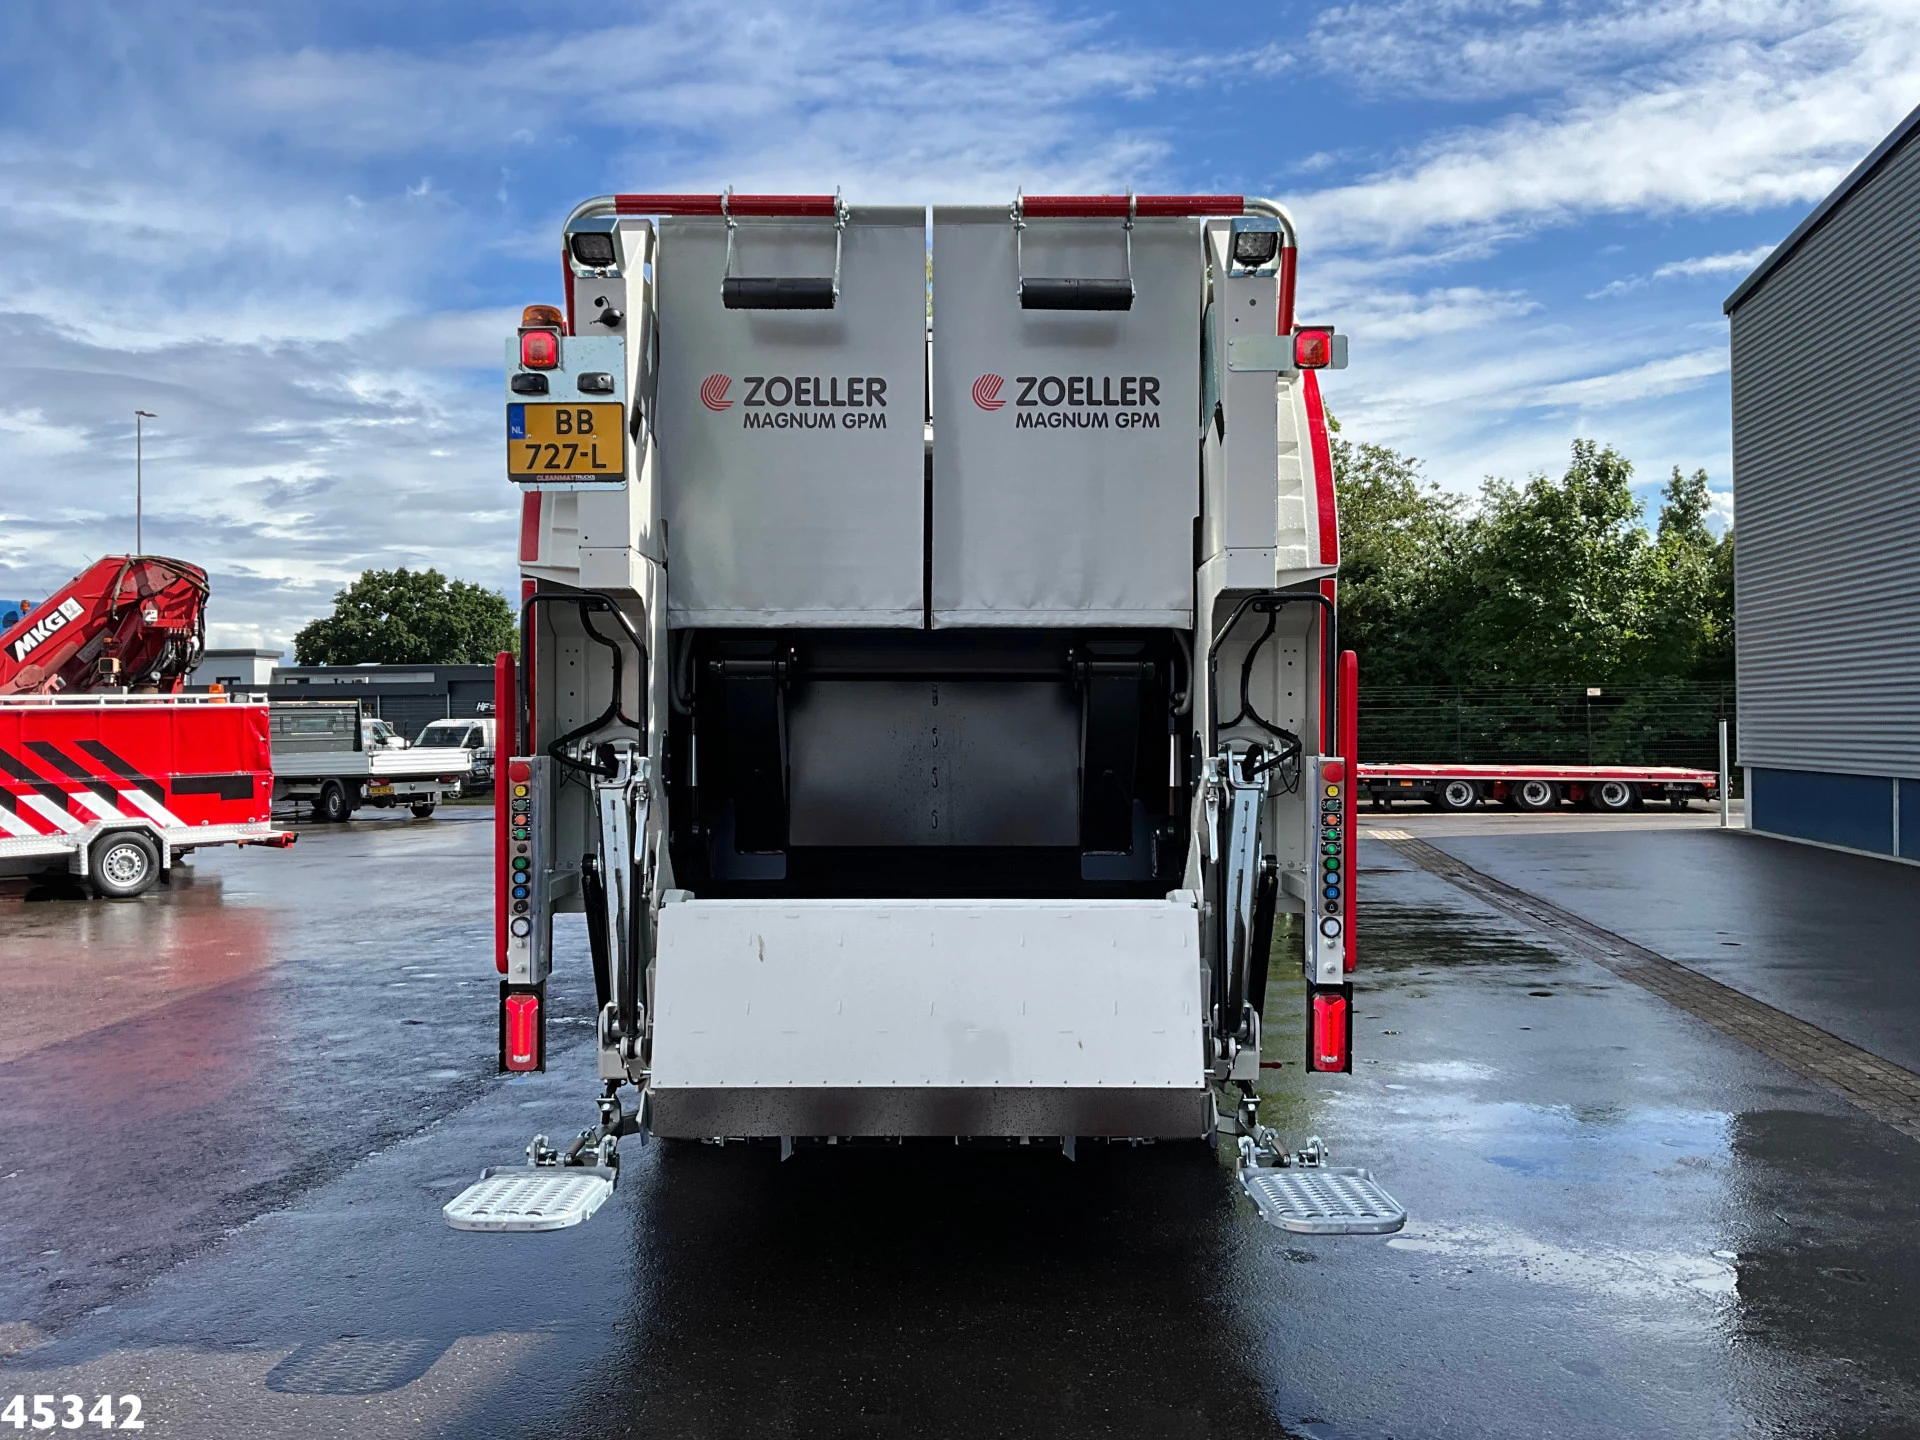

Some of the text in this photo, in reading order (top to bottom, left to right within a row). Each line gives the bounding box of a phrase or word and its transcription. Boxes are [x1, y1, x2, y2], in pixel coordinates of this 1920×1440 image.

[743, 376, 887, 407] ZOELLER
[1016, 376, 1161, 407] ZOELLER
[511, 426, 523, 434] NL
[556, 409, 594, 435] BB
[743, 412, 887, 429] MAGNUM GPM
[1016, 412, 1160, 429] MAGNUM GPM
[525, 443, 607, 470] 727-L
[14, 610, 68, 663] MKG
